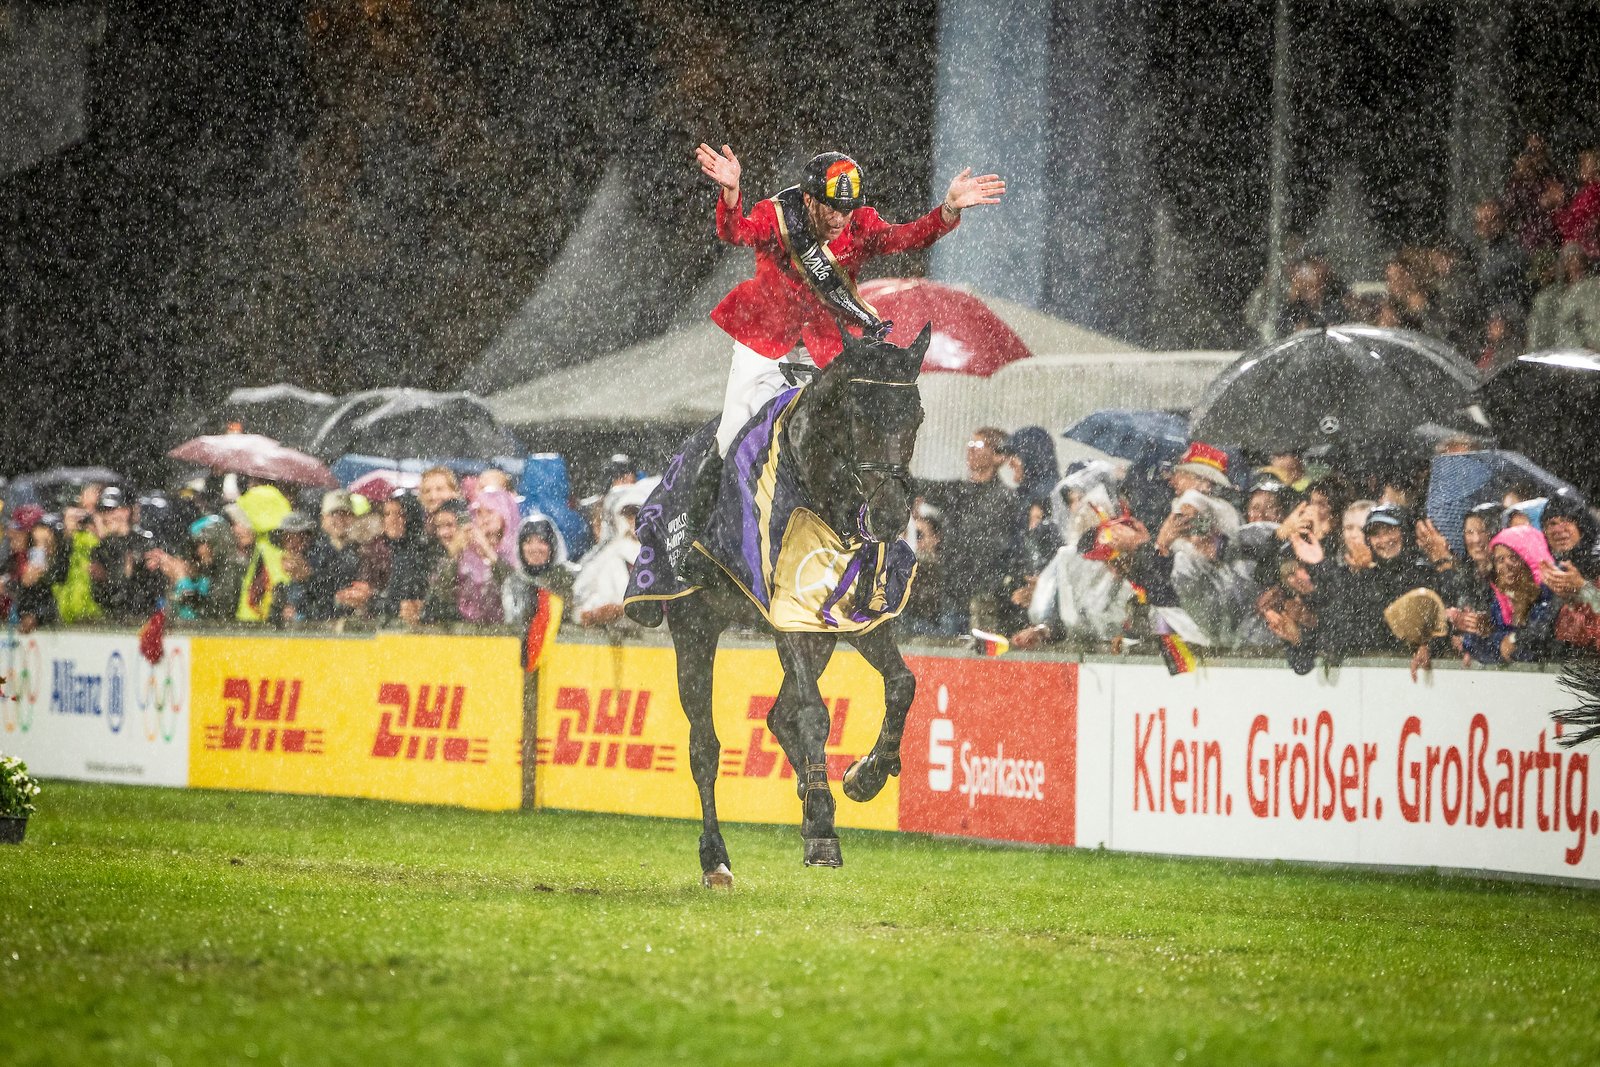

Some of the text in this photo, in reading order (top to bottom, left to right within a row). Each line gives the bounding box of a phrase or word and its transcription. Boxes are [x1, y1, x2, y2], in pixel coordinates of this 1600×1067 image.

[220, 678, 309, 753] DHL
[371, 683, 470, 762] DHL
[551, 687, 656, 769] DHL
[743, 696, 856, 781] DL
[959, 741, 1045, 808] Sparkasse
[1134, 708, 1600, 866] Klein. Größer. Großartig.
